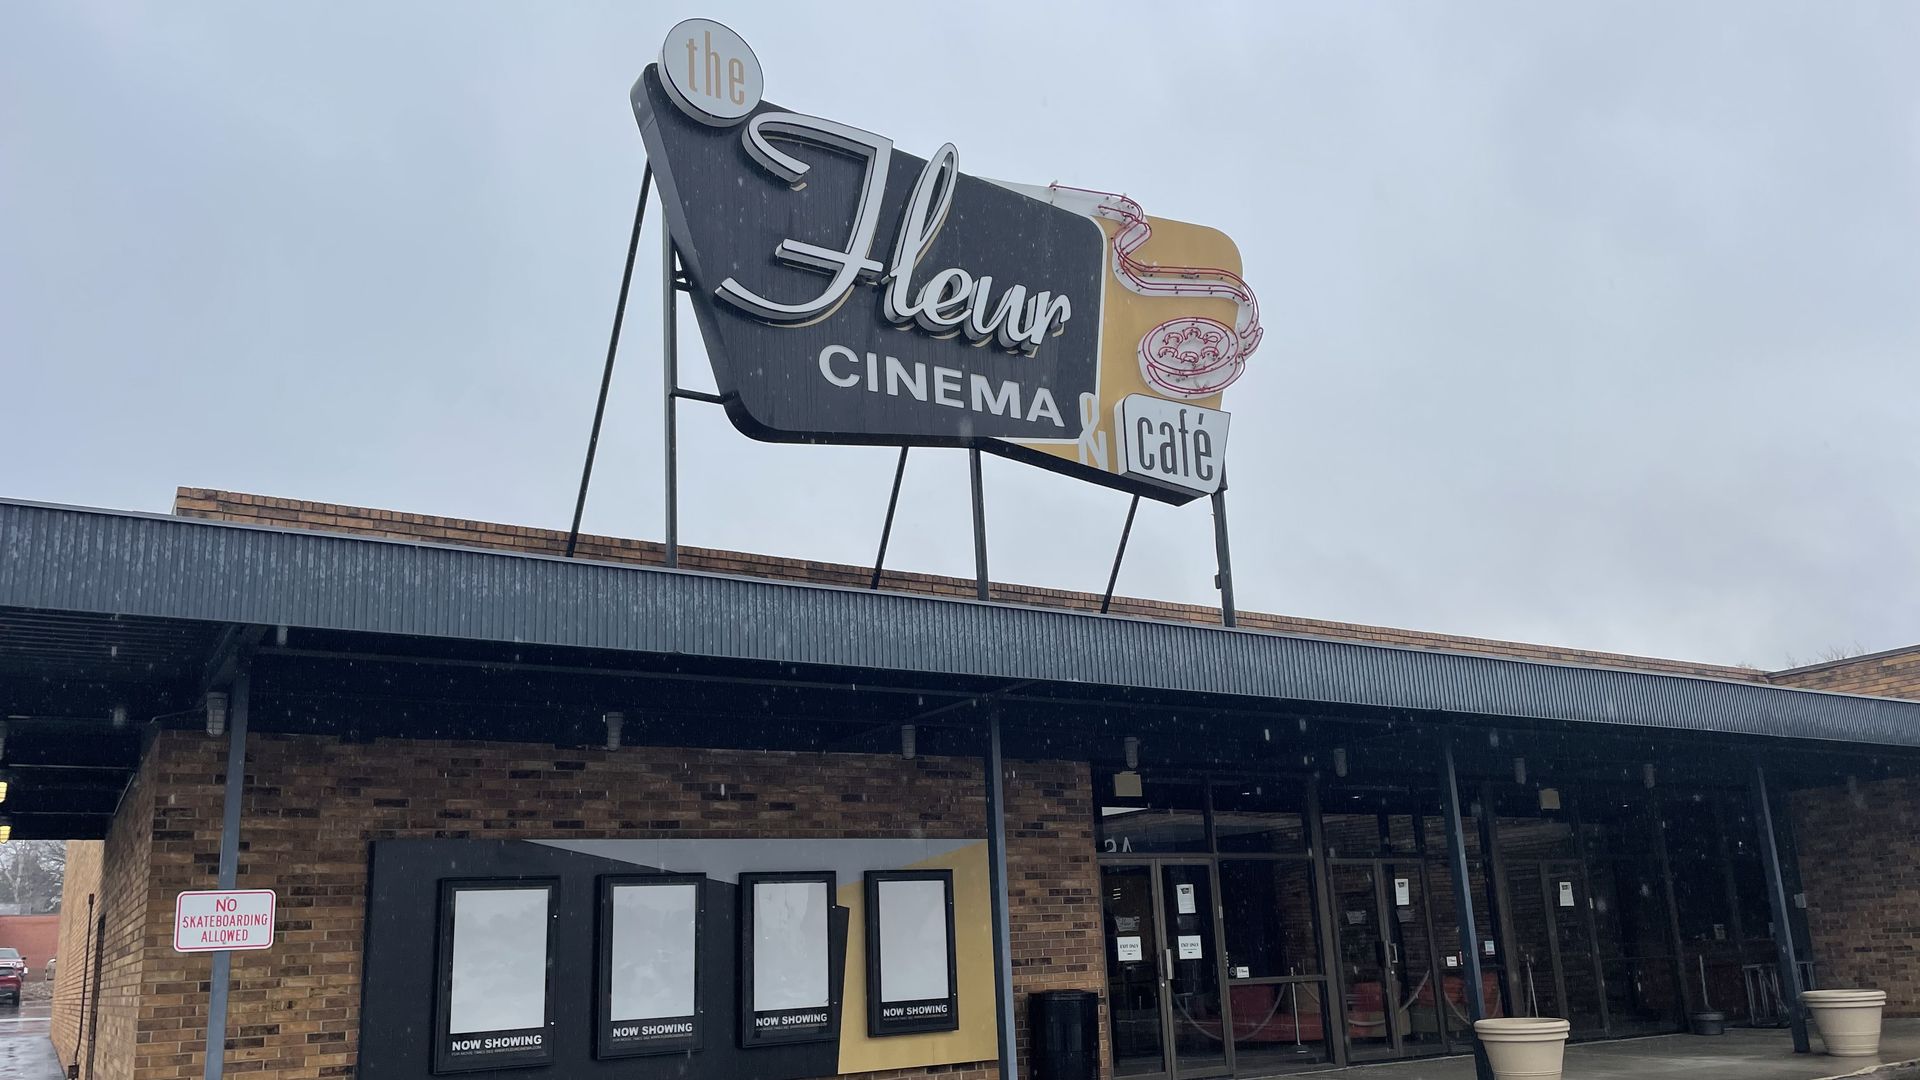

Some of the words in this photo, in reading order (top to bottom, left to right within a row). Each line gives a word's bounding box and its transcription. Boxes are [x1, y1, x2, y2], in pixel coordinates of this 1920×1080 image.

[686, 30, 746, 106] the
[715, 111, 1071, 347] Fleur
[818, 345, 1065, 428] CINEMA
[1137, 408, 1214, 481] café
[216, 898, 237, 912] NO
[182, 913, 268, 928] SKATEBOARDING
[201, 929, 248, 943] ALLOWED
[883, 1007, 904, 1017] NOW
[906, 1004, 948, 1015] SHOWING
[755, 1017, 779, 1027] NOW
[782, 1013, 828, 1025] SHOWING
[612, 1026, 639, 1037] NOW
[641, 1023, 693, 1035] SHOWING
[452, 1039, 481, 1051] NOW
[484, 1034, 542, 1049] SHOWING
